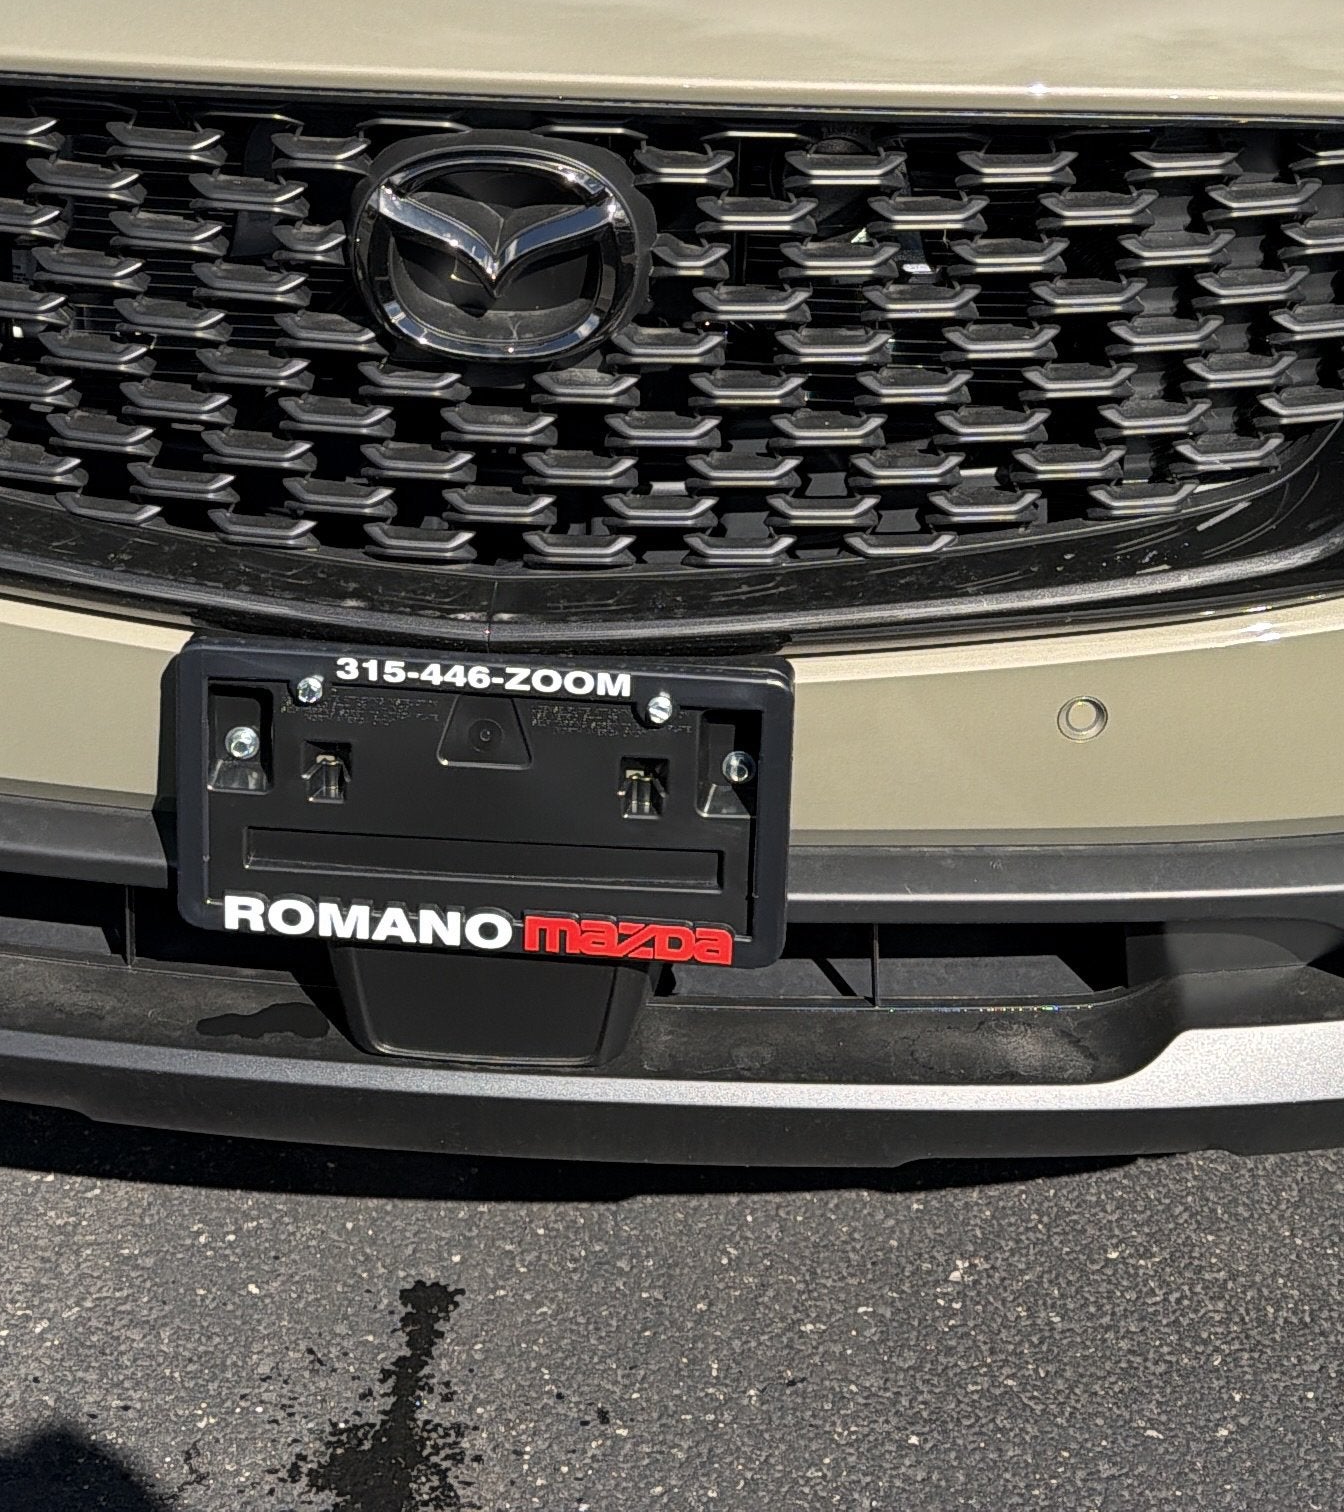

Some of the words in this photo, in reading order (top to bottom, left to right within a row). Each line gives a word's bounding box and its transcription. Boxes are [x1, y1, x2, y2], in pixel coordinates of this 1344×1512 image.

[335, 657, 632, 697] 315-446-ZOOM
[223, 894, 514, 951] ROMANO
[522, 913, 733, 966] mazda
